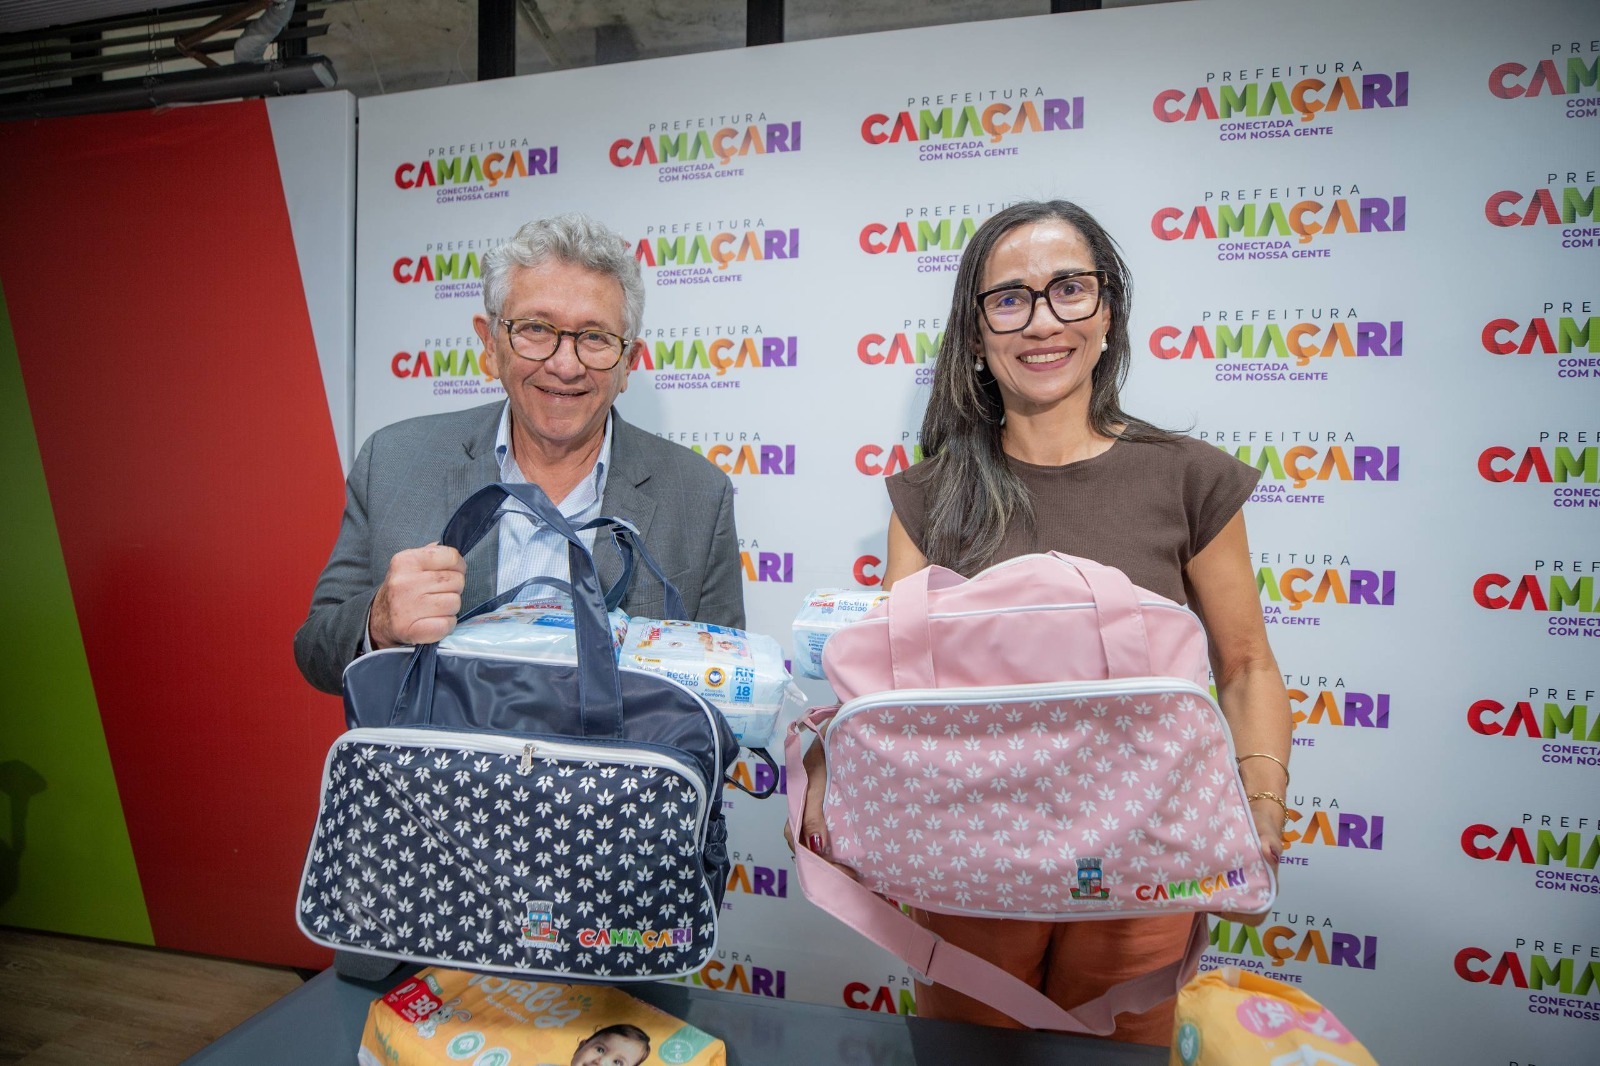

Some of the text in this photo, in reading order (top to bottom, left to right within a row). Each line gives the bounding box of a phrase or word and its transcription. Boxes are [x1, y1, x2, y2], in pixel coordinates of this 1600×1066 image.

[1206, 60, 1363, 83] PREFEITURA
[908, 86, 1044, 108] PREFEITURA
[1152, 71, 1409, 122] CAMAÇARI
[861, 96, 1084, 144] CAMAÇARI
[1566, 109, 1597, 118] COM
[650, 112, 767, 132] PREFEITURA
[1220, 120, 1294, 132] CONECTADA
[1220, 127, 1334, 142] COM NOSSA GENTE
[428, 138, 528, 157] PREFEITURA
[608, 121, 801, 168] CAMAÇARI
[920, 141, 984, 152] CONECTADA
[920, 148, 1018, 162] COM NOSSA GENTE
[394, 146, 558, 190] CAMAÇARI
[659, 164, 714, 174] CONECTADA
[659, 169, 744, 182] COM NOSSA GENTE
[436, 185, 484, 196] CONECTADA
[436, 190, 509, 204] COM NOSSA GENTE
[1205, 184, 1360, 202] PREFEITURA
[906, 203, 1011, 218] PREFEIT
[647, 218, 765, 235] PREFEITURA
[1150, 196, 1406, 244] CAMAÇARI
[859, 218, 977, 254] CAMA
[624, 228, 800, 270] AMAÇARI
[1218, 241, 1292, 251] CONECTADA
[1562, 239, 1593, 248] COM
[918, 255, 962, 264] CONECT
[1218, 249, 1331, 261] COM NOSSA GENTE
[393, 252, 481, 284] CAMA
[657, 268, 712, 278] CONECTADA
[434, 282, 482, 292] CONECTADA
[657, 274, 742, 286] COM NOSSA GENTE
[454, 290, 480, 298] NOSSA
[1203, 308, 1358, 322] PREFEITURA
[645, 325, 763, 338] PREFEITURA
[425, 337, 480, 348] PREFEI
[1148, 321, 1404, 366] CAMAÇARI
[632, 336, 798, 376] AMAÇARI
[391, 349, 494, 382] CAMAÇ
[1216, 363, 1289, 372] CONECTADA
[655, 373, 710, 382] CONECTADA
[1216, 372, 1328, 382] COM NOSSA GENTE
[1558, 370, 1589, 378] COM
[434, 380, 480, 388] CONECTADA
[655, 382, 675, 390] COM
[678, 382, 708, 390] NOSSA
[656, 432, 761, 442] EFEITURA
[1200, 432, 1354, 442] PREFEITURA
[690, 444, 796, 475] ÇARI
[1218, 446, 1400, 489] AÇARI
[1286, 494, 1324, 504] GENTE
[1554, 488, 1600, 497] CONEC
[1554, 499, 1584, 508] COM
[1250, 553, 1350, 566] EITURA
[1256, 567, 1396, 610] AÇARI
[1282, 616, 1320, 626] GENTE
[1548, 627, 1578, 636] COM
[736, 686, 750, 696] 18
[1287, 688, 1390, 731] ÇARI
[1292, 738, 1315, 746] NTE
[1542, 744, 1600, 756] CONECT
[1542, 754, 1572, 764] COM
[1281, 808, 1384, 850] ÇARI
[1279, 856, 1308, 866] ENTE
[1136, 867, 1246, 901] CAMAÇARI
[1536, 870, 1600, 884] CONECTA
[1536, 880, 1600, 894] COM NOS
[579, 928, 692, 950] CAMAÇARI
[1516, 938, 1600, 958] PREFE
[1200, 954, 1264, 969] ONECTADA
[1264, 971, 1302, 983] GENTE
[1454, 946, 1600, 996] CAMA
[408, 994, 438, 1016] 38
[1529, 994, 1600, 1011] CONECTAD
[1528, 1004, 1600, 1021] COM NOSS
